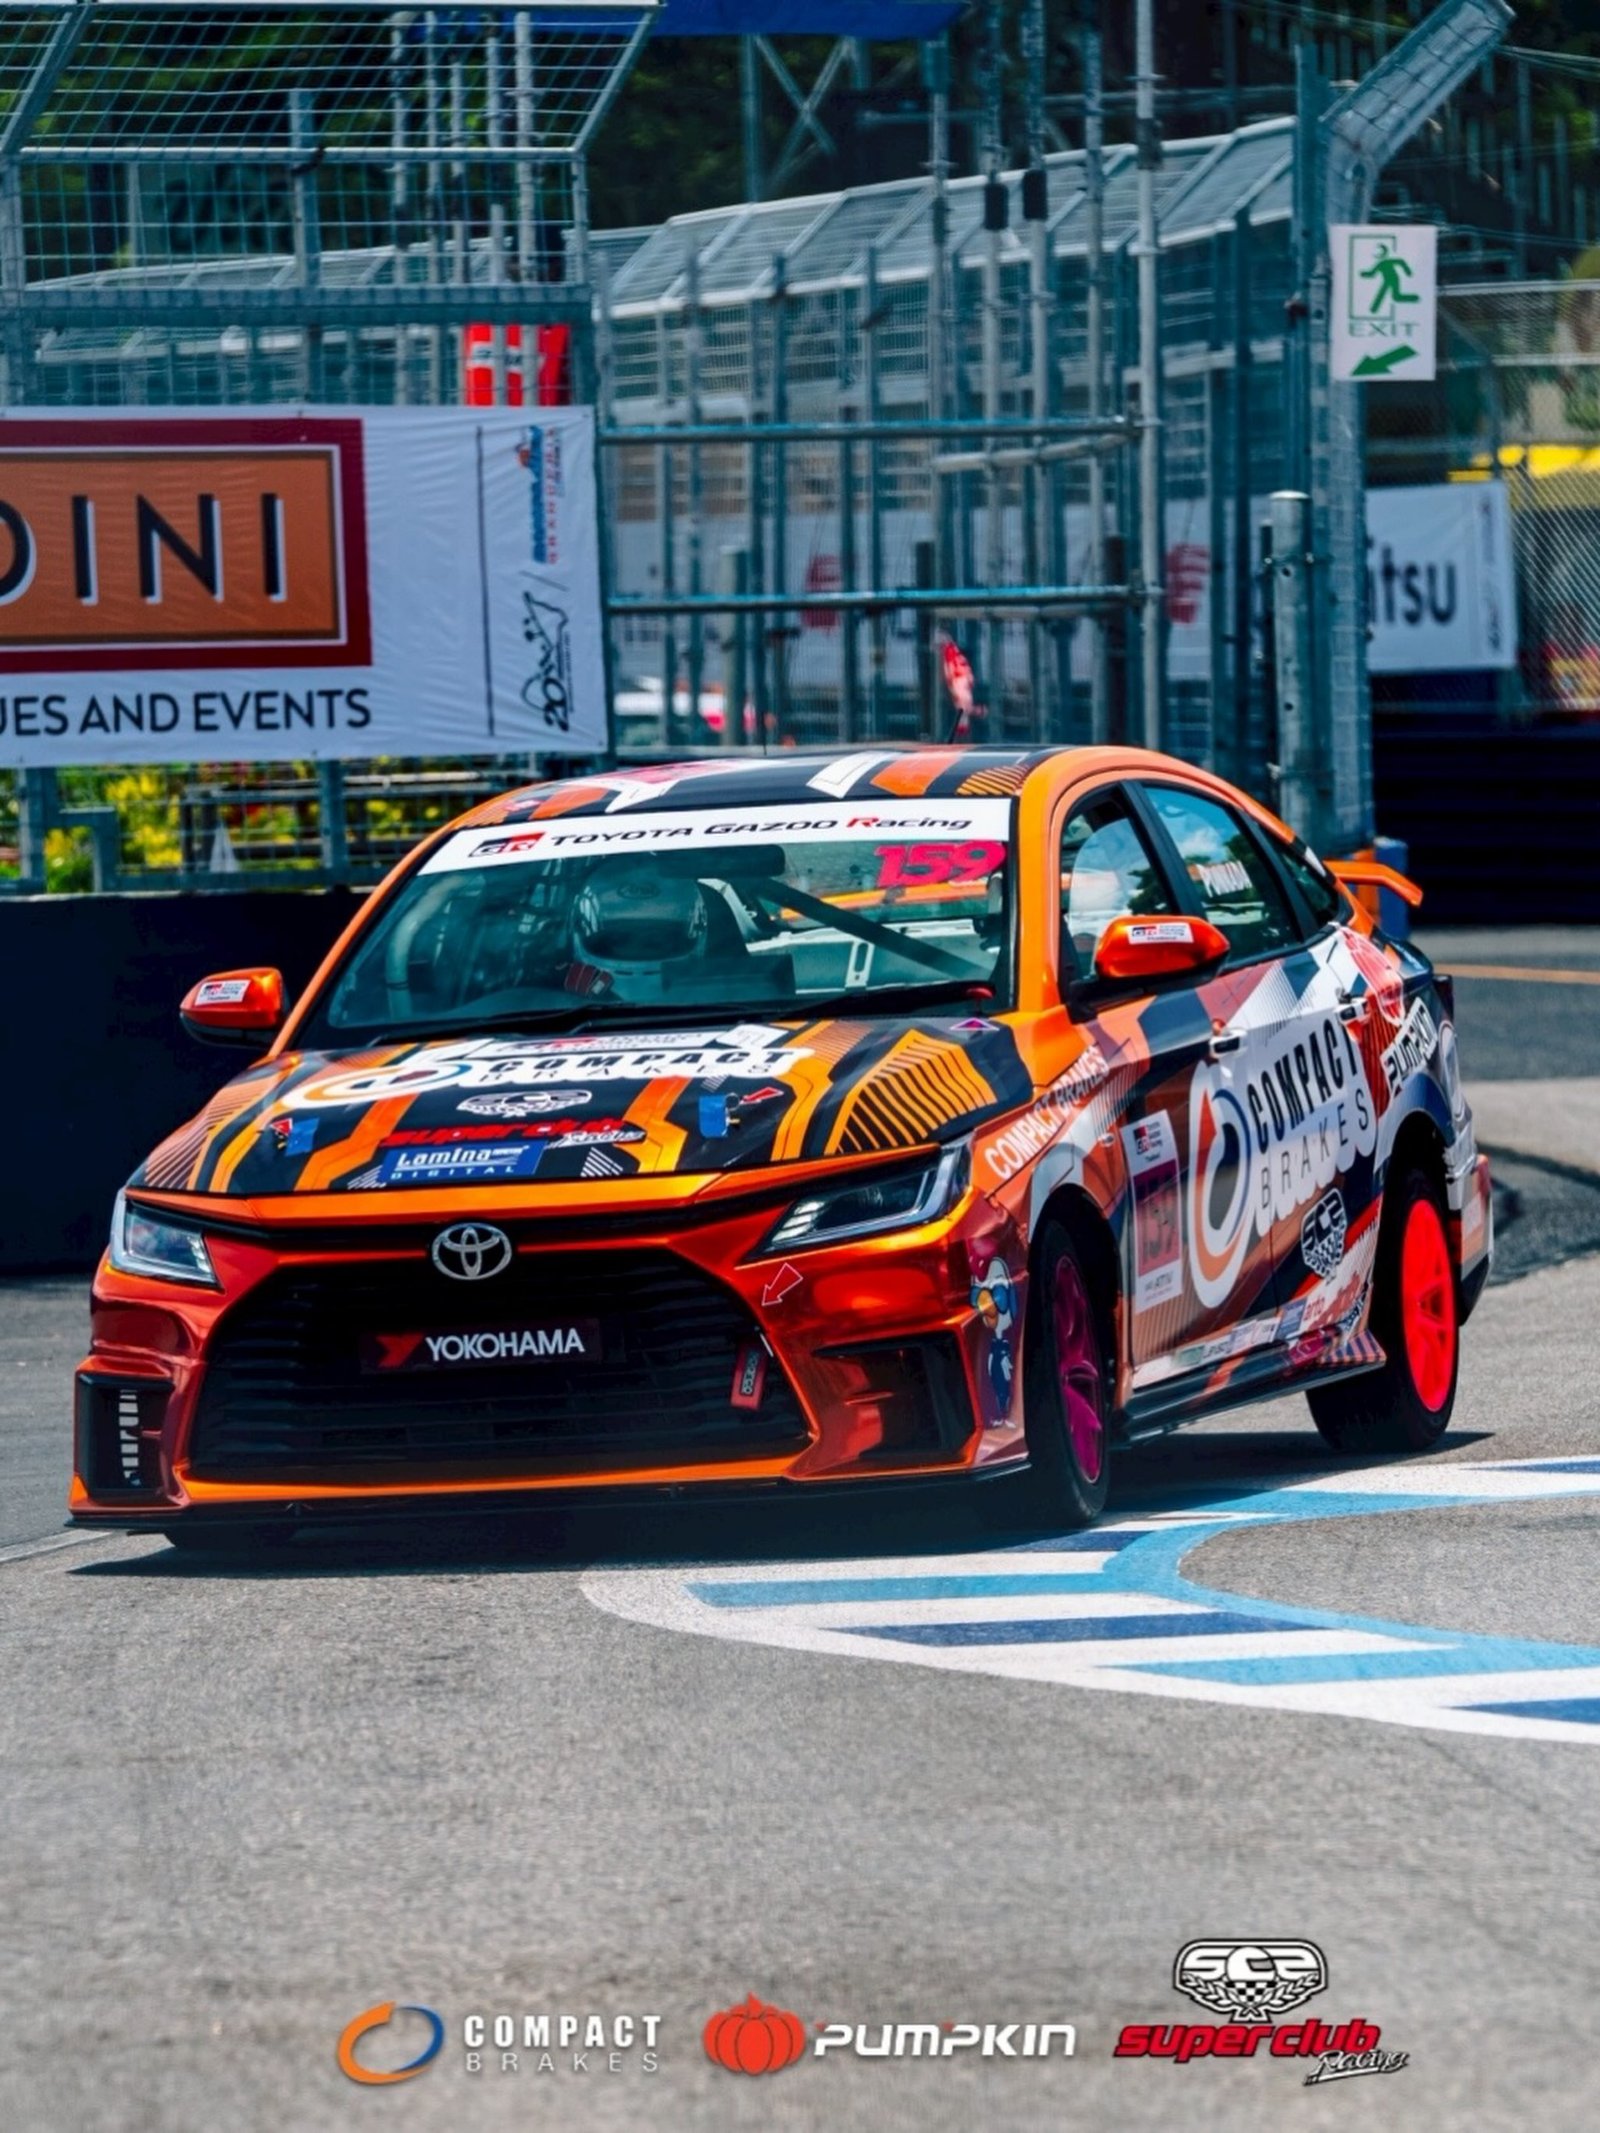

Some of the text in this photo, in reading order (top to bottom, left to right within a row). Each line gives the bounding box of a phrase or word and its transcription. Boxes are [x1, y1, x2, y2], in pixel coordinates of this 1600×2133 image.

[1349, 322, 1419, 338] EXIT
[79, 692, 180, 735] AND
[193, 688, 372, 732] EVENTS
[552, 827, 693, 847] TOYOTA
[703, 819, 838, 836] GAZOO
[847, 816, 973, 832] Racing
[874, 838, 1007, 889] 159
[487, 1050, 794, 1073] COMPACT
[1246, 1018, 1358, 1155] COMPACT
[984, 1091, 1064, 1180] COMPACT
[1260, 1088, 1370, 1210] BRAKES
[397, 1147, 491, 1168] Lamina
[425, 1328, 585, 1362] YOKOHAMA
